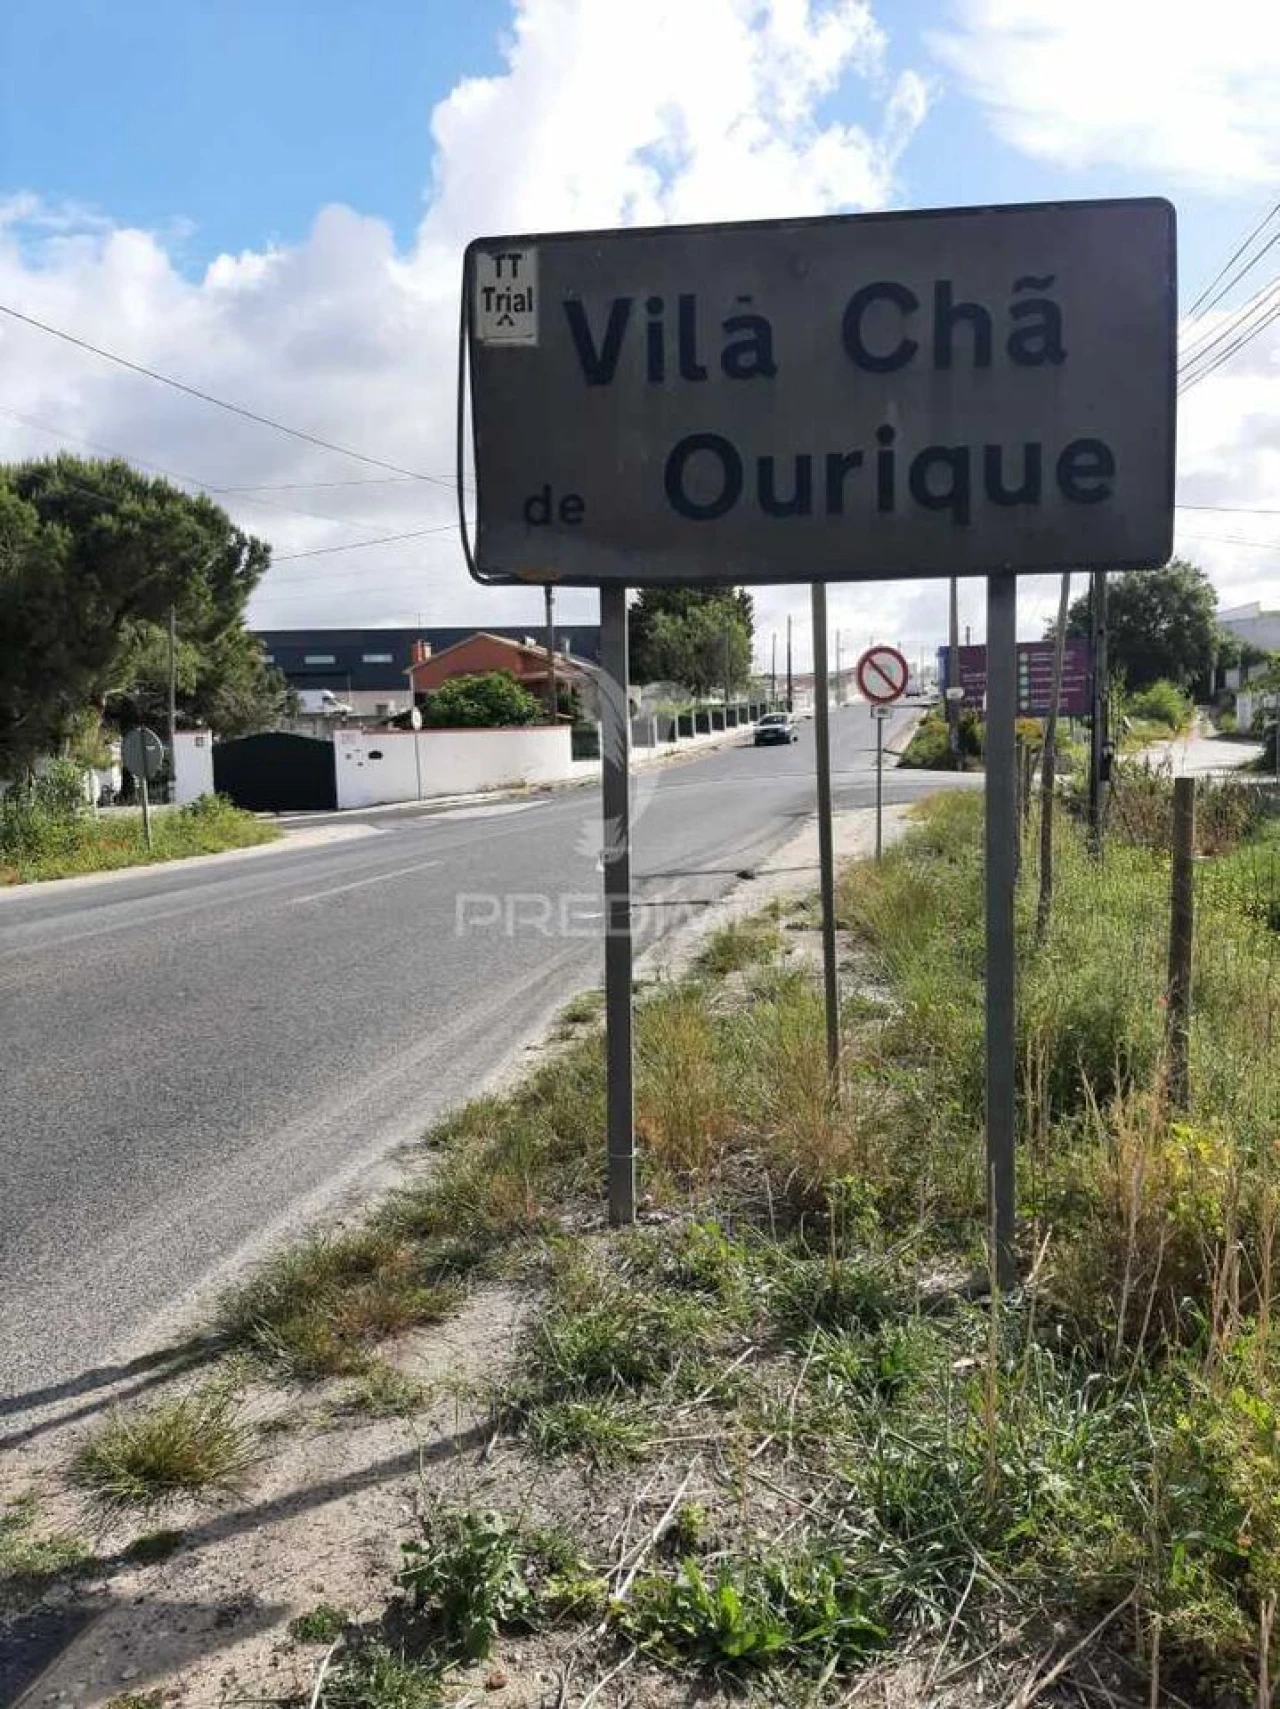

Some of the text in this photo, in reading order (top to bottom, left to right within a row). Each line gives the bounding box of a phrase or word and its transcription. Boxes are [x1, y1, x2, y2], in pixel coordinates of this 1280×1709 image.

[491, 253, 522, 278] TT
[482, 286, 533, 312] Trial
[842, 275, 1068, 375] Chã
[523, 424, 1117, 528] de Ourique
